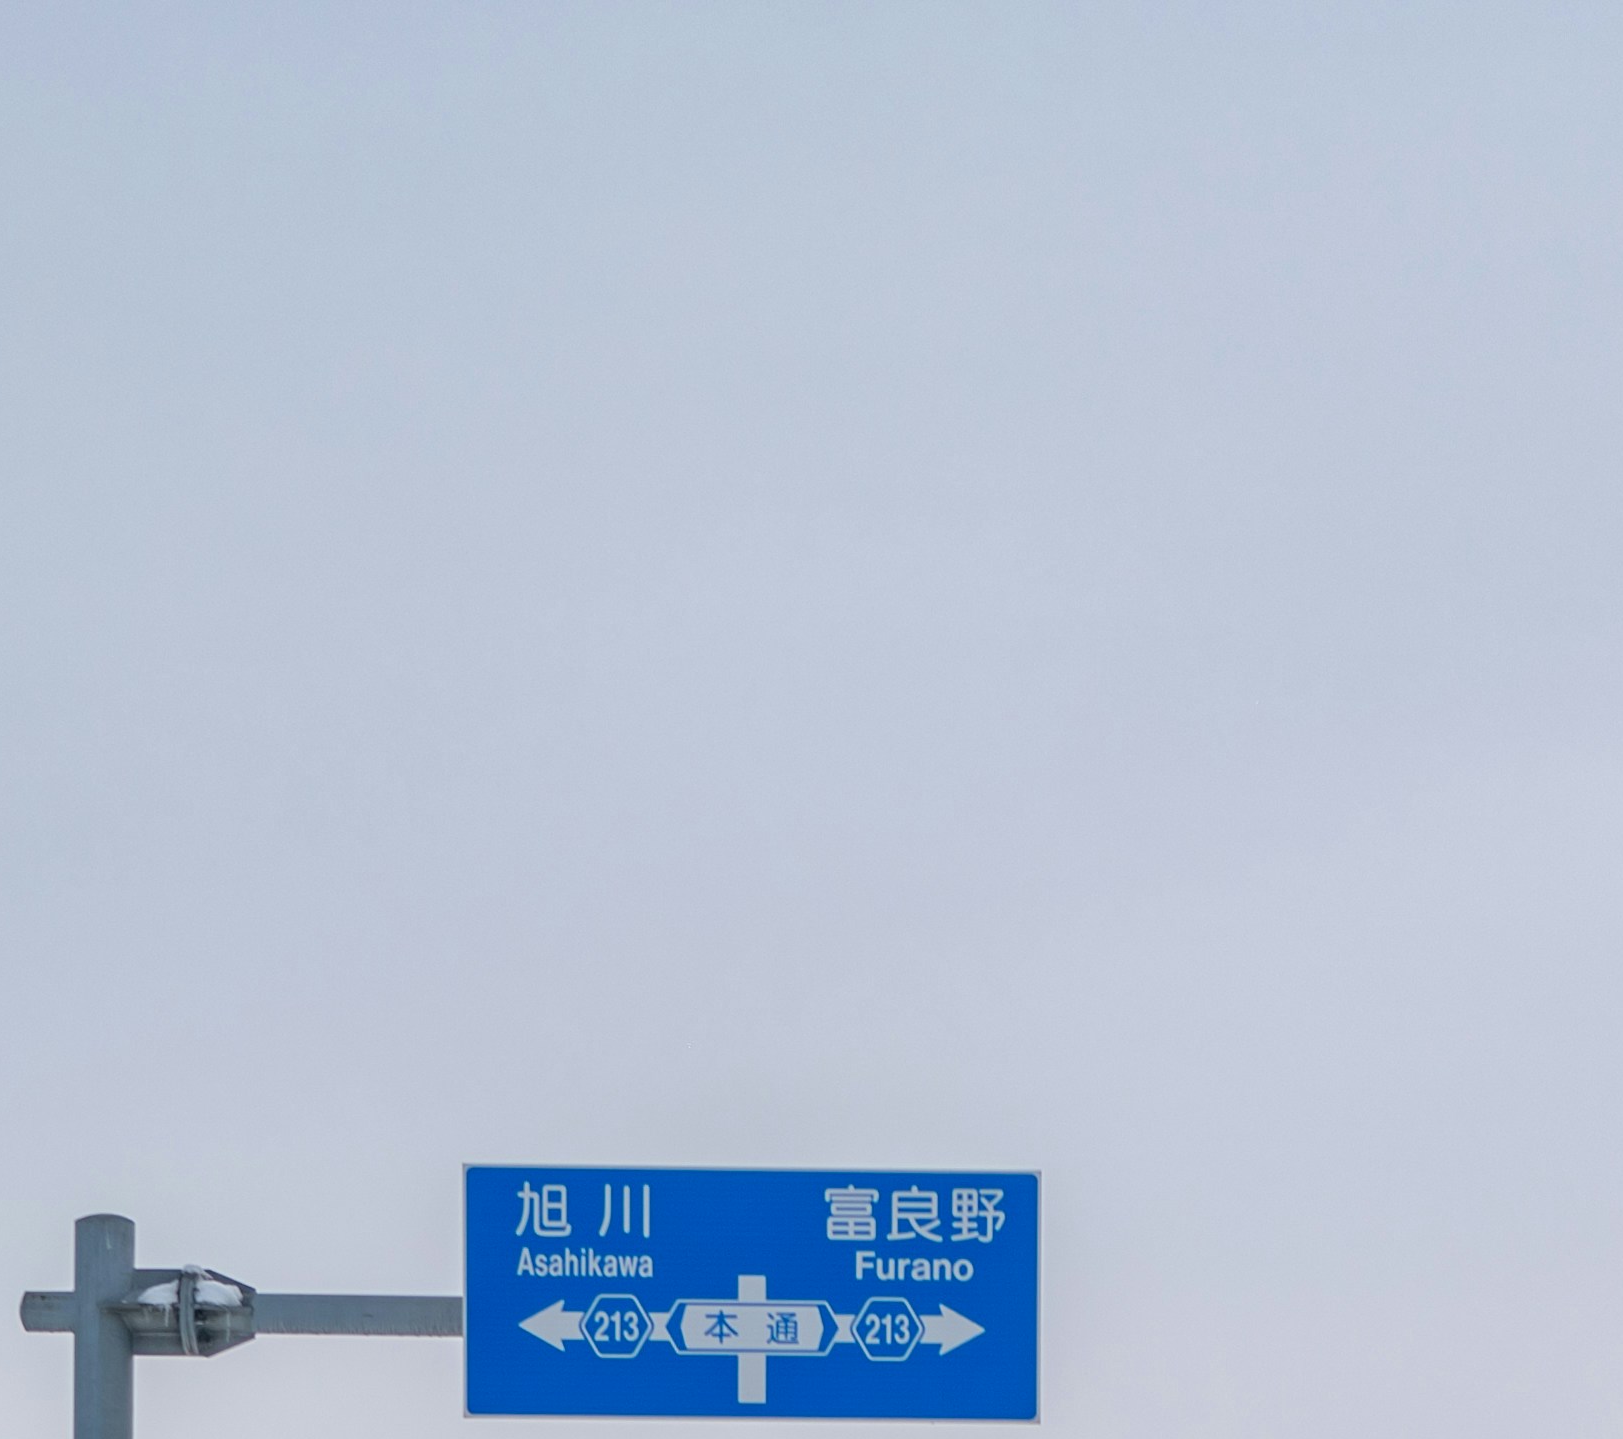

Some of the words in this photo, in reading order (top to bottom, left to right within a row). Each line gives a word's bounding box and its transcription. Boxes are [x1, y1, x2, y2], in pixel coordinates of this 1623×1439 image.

[514, 1182, 652, 1239] 旭川
[824, 1185, 1007, 1243] 富良野
[516, 1248, 654, 1279] Asahikawa
[855, 1251, 975, 1281] Furano
[594, 1309, 640, 1342] 213
[703, 1310, 801, 1345] 本通
[865, 1313, 911, 1346] 213
